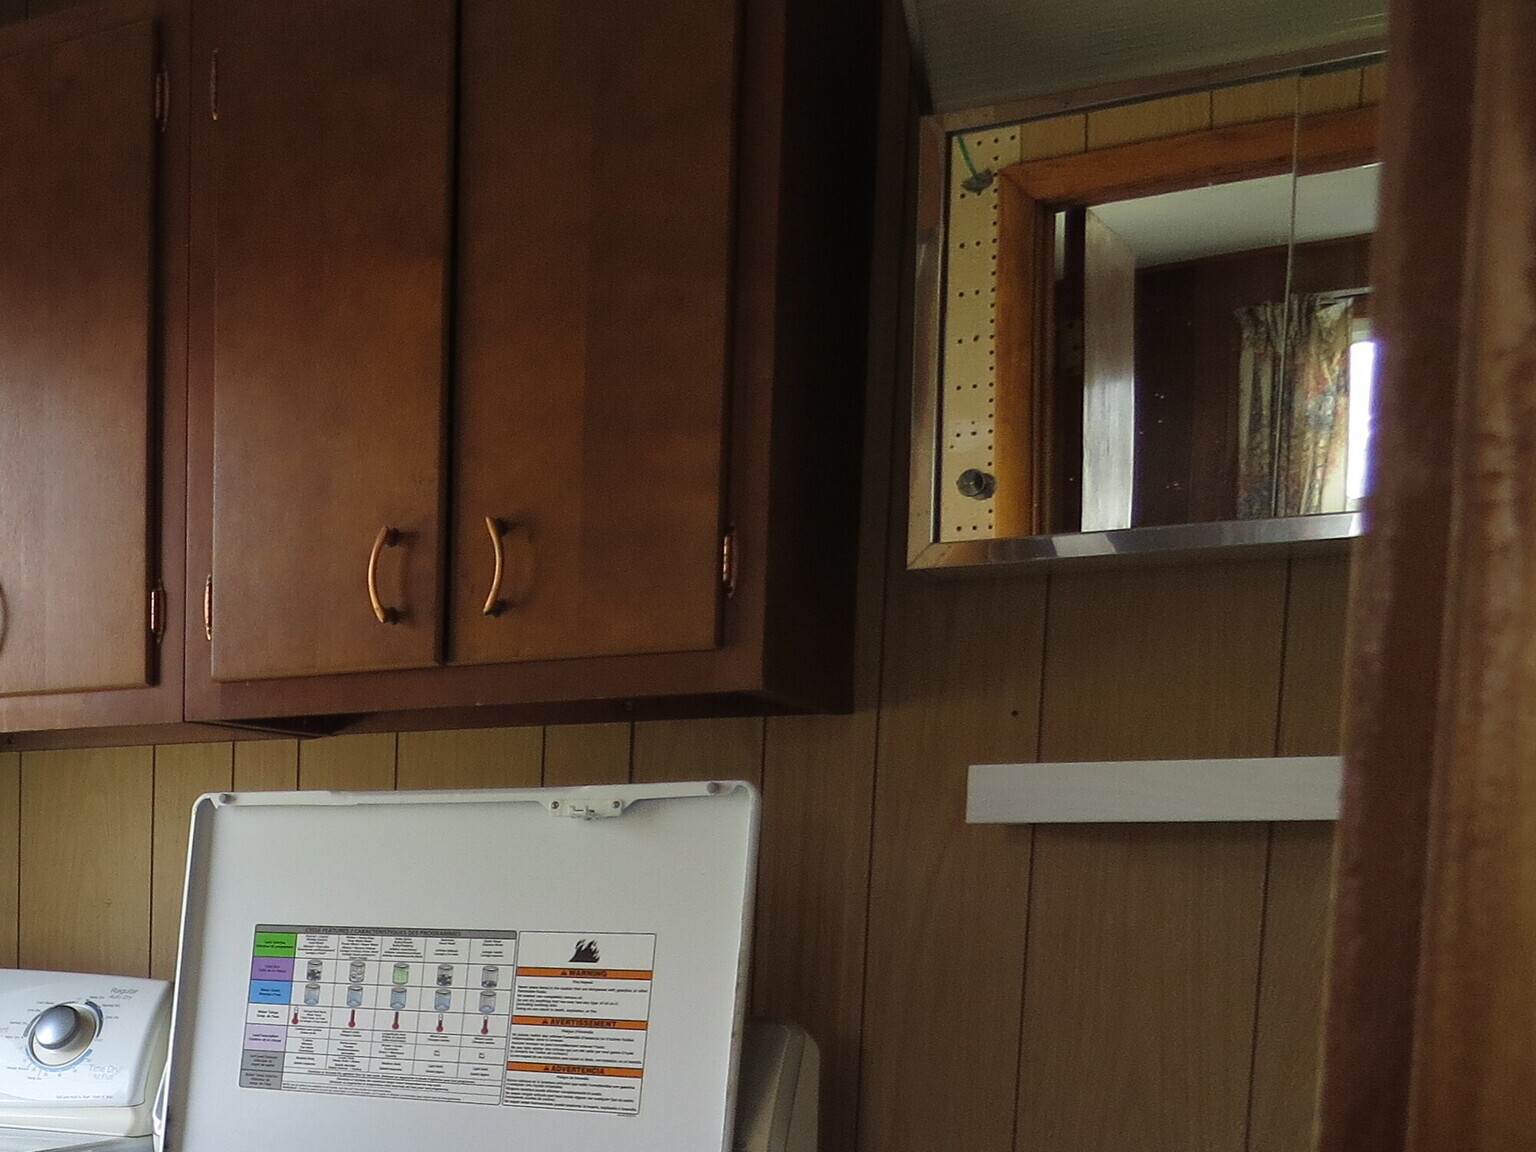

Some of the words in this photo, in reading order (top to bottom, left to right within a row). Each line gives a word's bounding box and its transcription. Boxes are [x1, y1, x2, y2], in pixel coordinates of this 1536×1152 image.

[110, 987, 139, 995] Regular
[550, 1019, 617, 1028] AVERTISSEMENT
[551, 1065, 605, 1074] ADVERTENCIA
